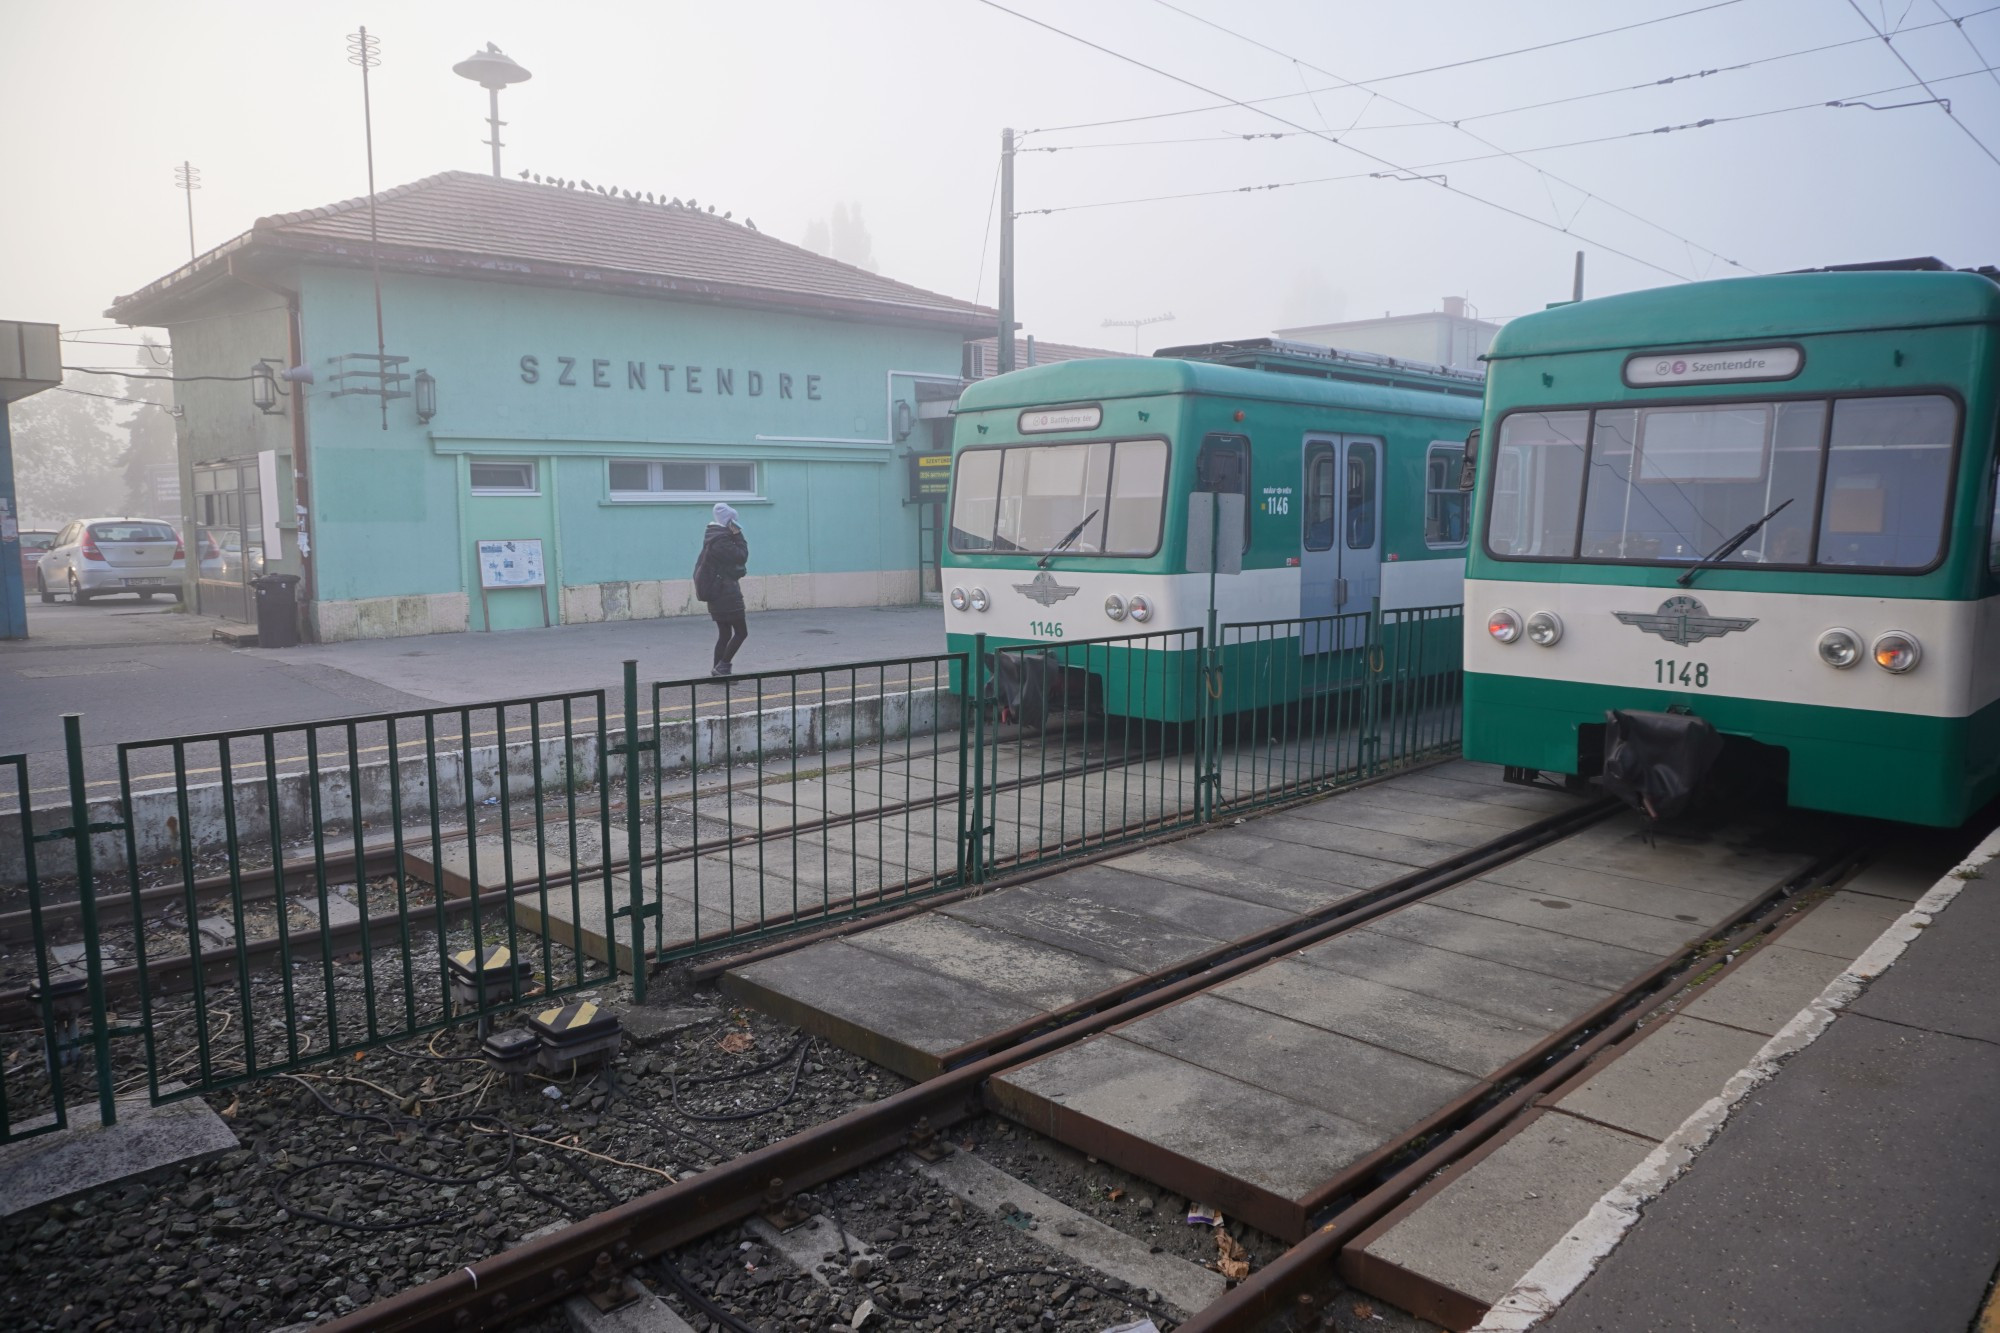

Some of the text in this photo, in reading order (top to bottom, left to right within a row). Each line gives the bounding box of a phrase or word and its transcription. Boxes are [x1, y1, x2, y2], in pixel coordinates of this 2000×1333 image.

[1692, 358, 1766, 373] Szentendre
[520, 354, 822, 401] SZENTENDRE
[1267, 496, 1289, 515] 1146
[1663, 596, 1702, 609] BKV
[1030, 620, 1064, 638] 1146
[1655, 658, 1709, 688] 1148
